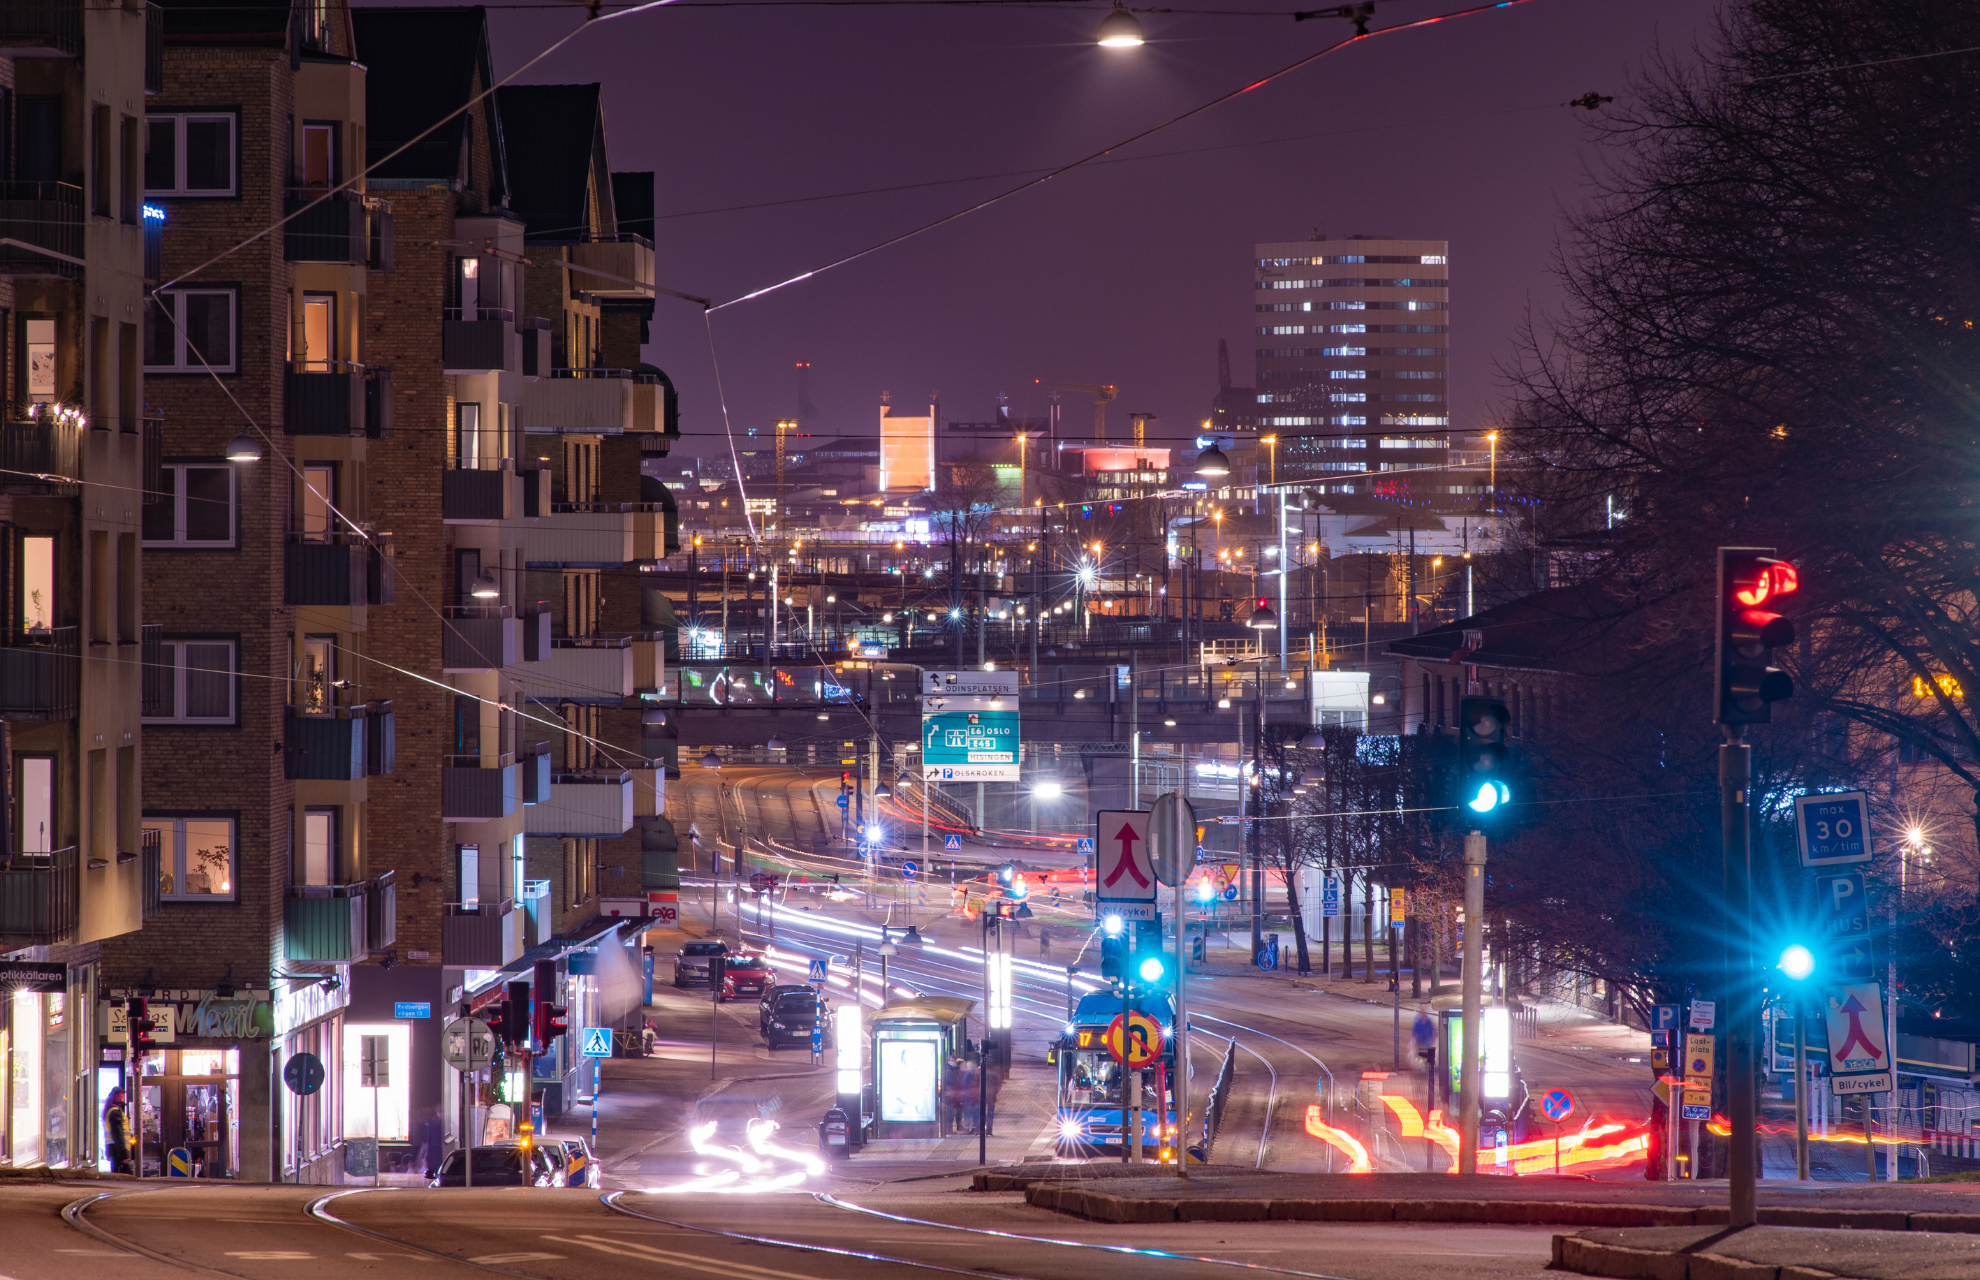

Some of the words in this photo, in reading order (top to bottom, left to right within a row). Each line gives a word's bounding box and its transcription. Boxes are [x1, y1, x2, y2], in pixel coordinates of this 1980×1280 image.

[1819, 806, 1845, 815] max
[1816, 819, 1853, 840] 30
[1812, 841, 1860, 854] km/tim
[1831, 878, 1855, 911] P
[651, 906, 677, 920] eva
[1103, 906, 1149, 917] Bil/cykel
[1826, 917, 1863, 934] HUS
[0, 970, 62, 981] ptikkällaren
[1659, 1006, 1674, 1029] P
[1079, 1033, 1092, 1047] 17
[1690, 1036, 1711, 1045] Last-
[1838, 1078, 1885, 1090] Bil/cykel
[1497, 1134, 1506, 1142] 30
